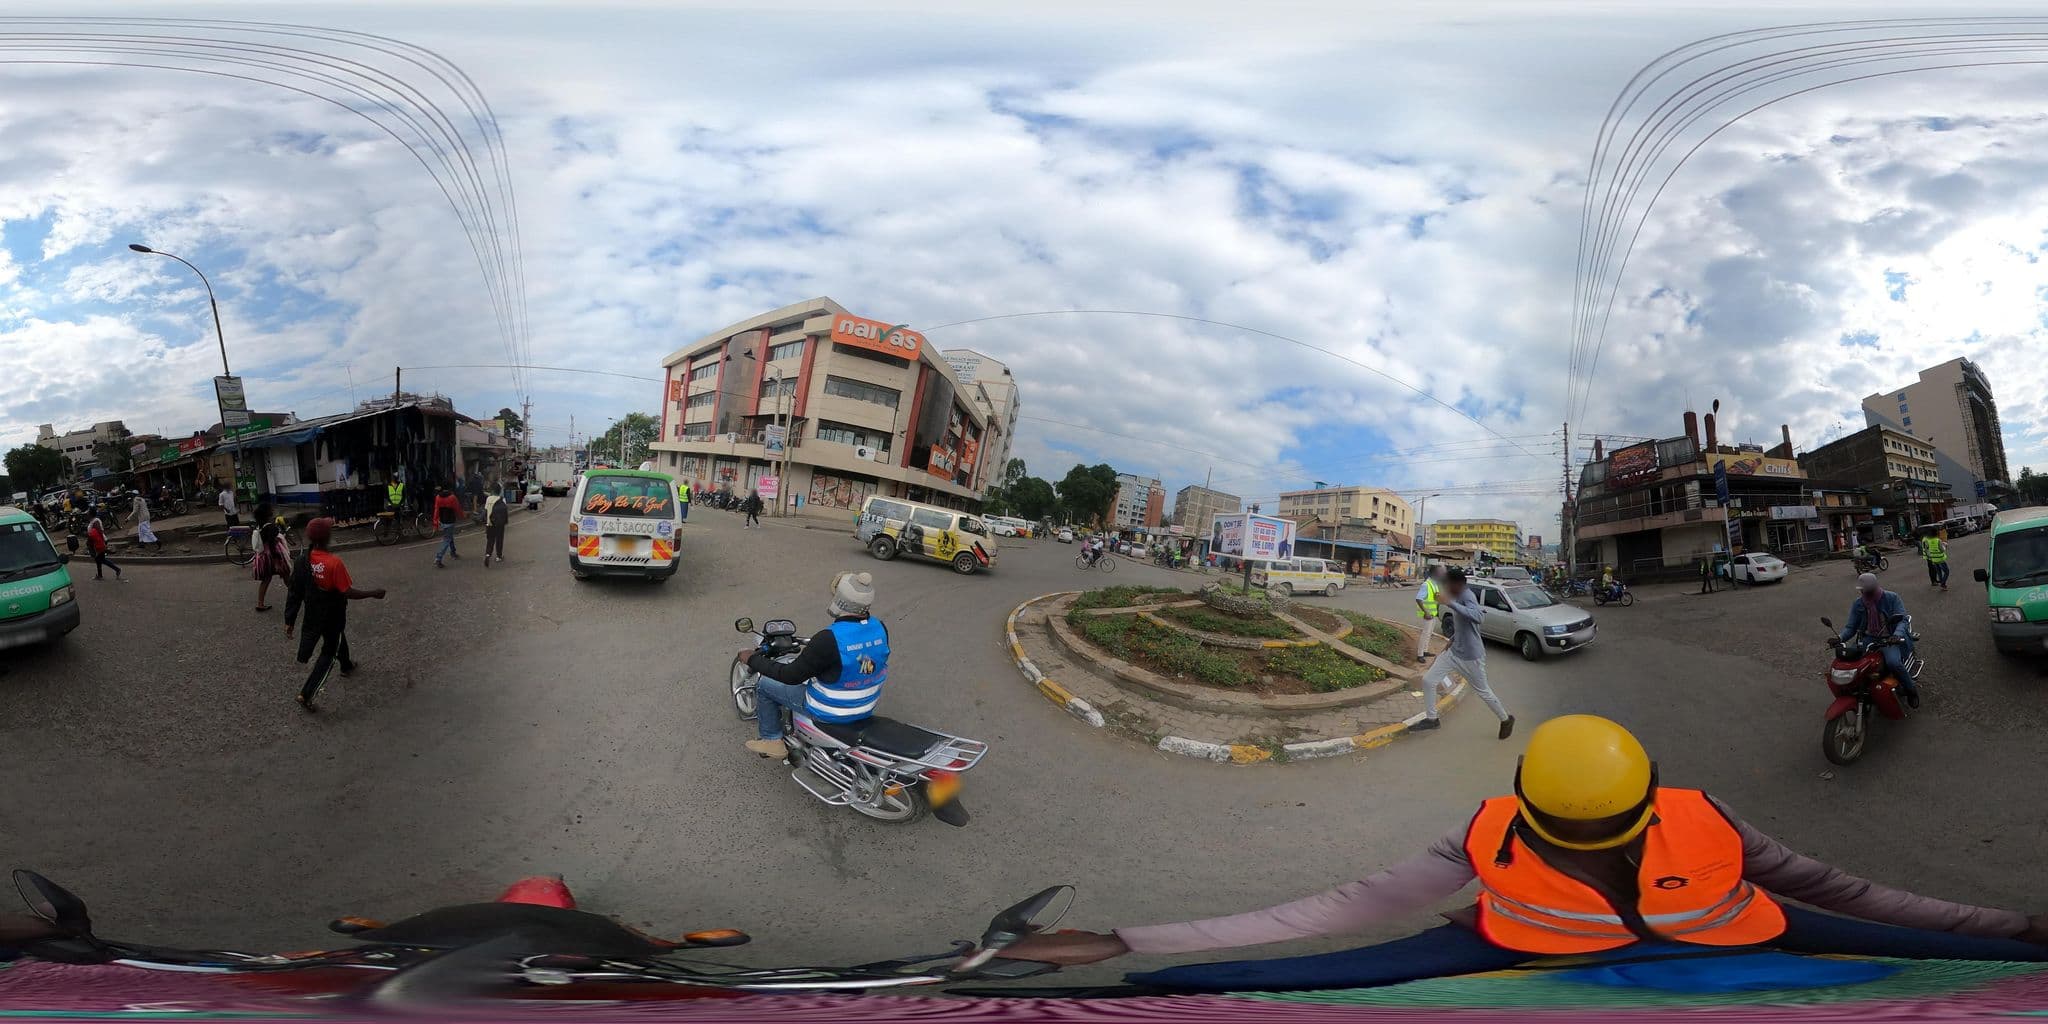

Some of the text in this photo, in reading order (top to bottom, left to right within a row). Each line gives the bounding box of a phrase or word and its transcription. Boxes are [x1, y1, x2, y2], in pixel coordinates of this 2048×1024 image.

[838, 319, 917, 351] naivas
[587, 493, 668, 513] Glory Be To God
[623, 523, 655, 534] SACCO
[1252, 540, 1274, 550] THE LORD
